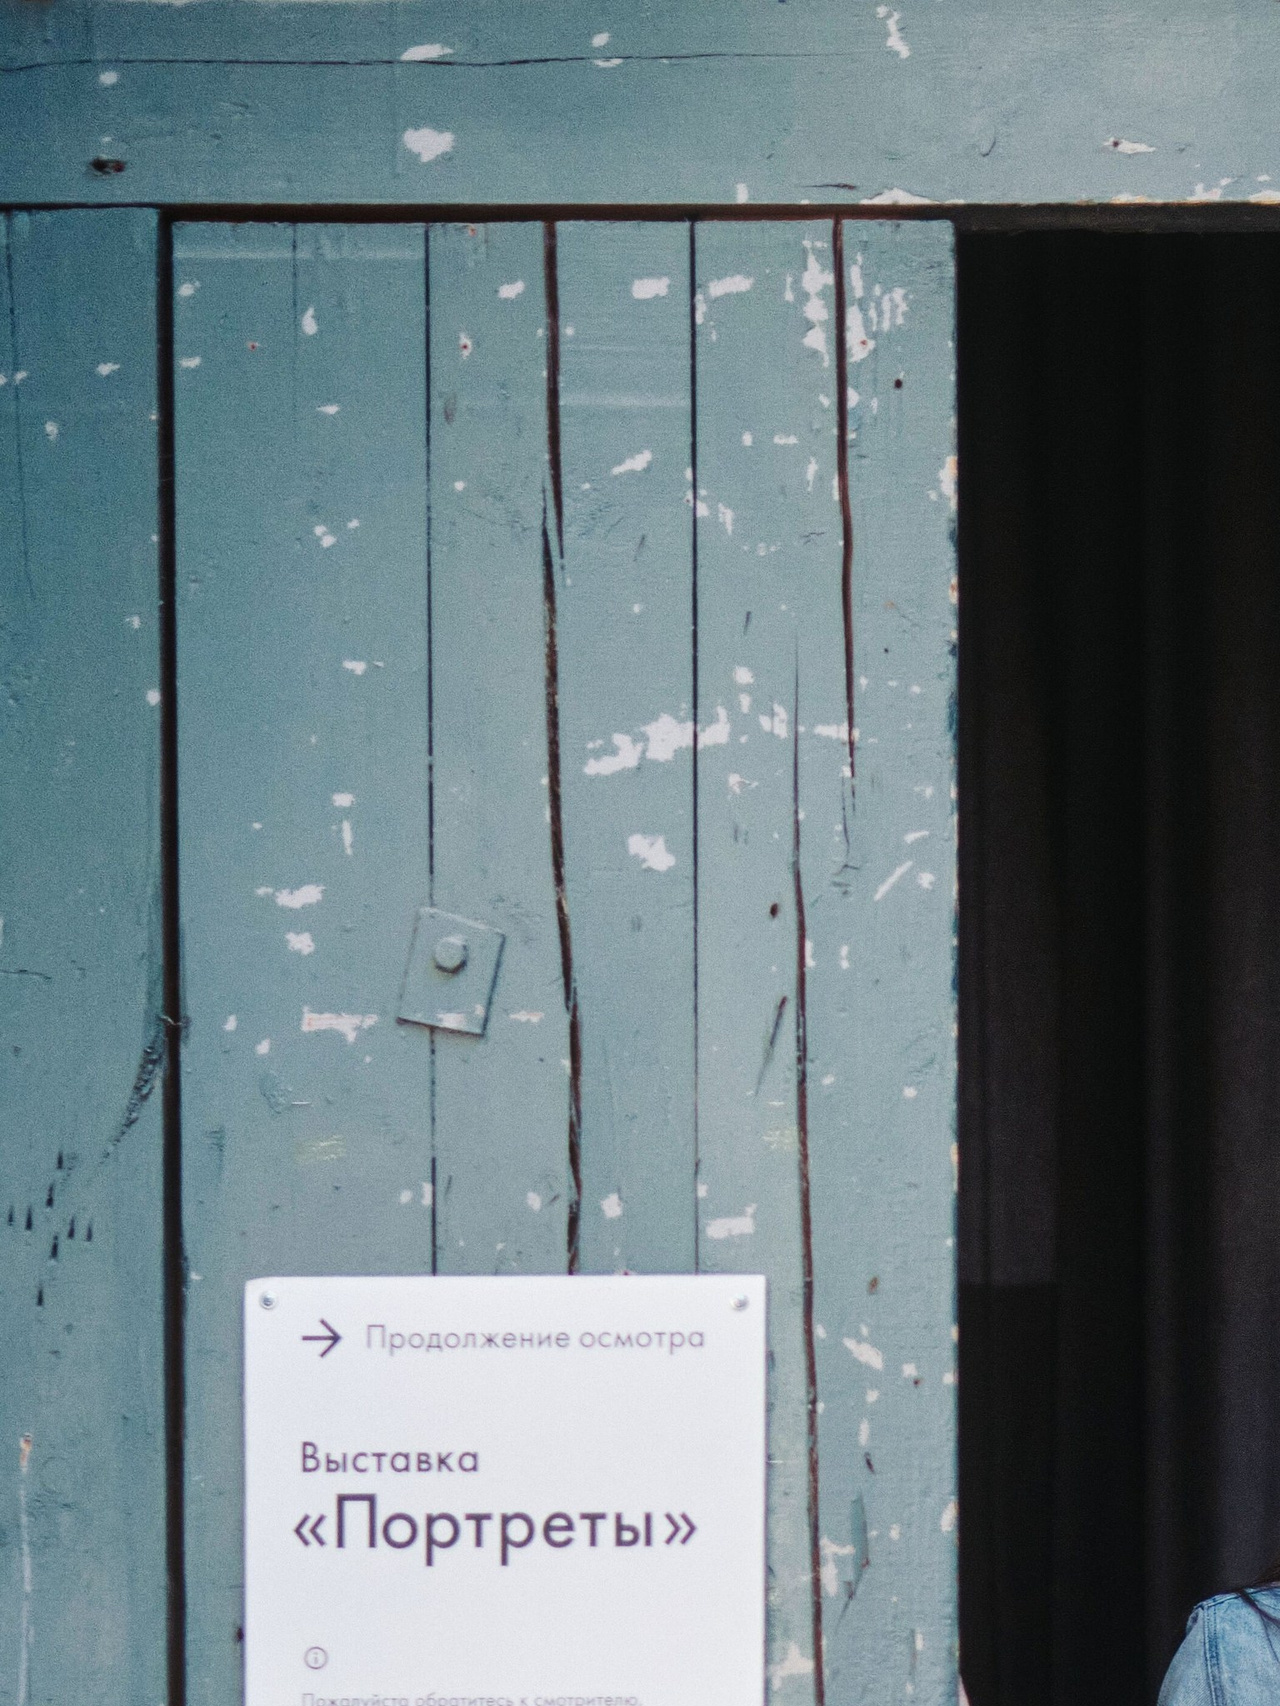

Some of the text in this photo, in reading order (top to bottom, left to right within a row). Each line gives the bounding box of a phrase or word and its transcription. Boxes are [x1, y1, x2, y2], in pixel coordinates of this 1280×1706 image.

[365, 1322, 706, 1357] Продолжение осмотра
[300, 1440, 480, 1475] Выставка
[293, 1492, 698, 1568] «Портреты»
